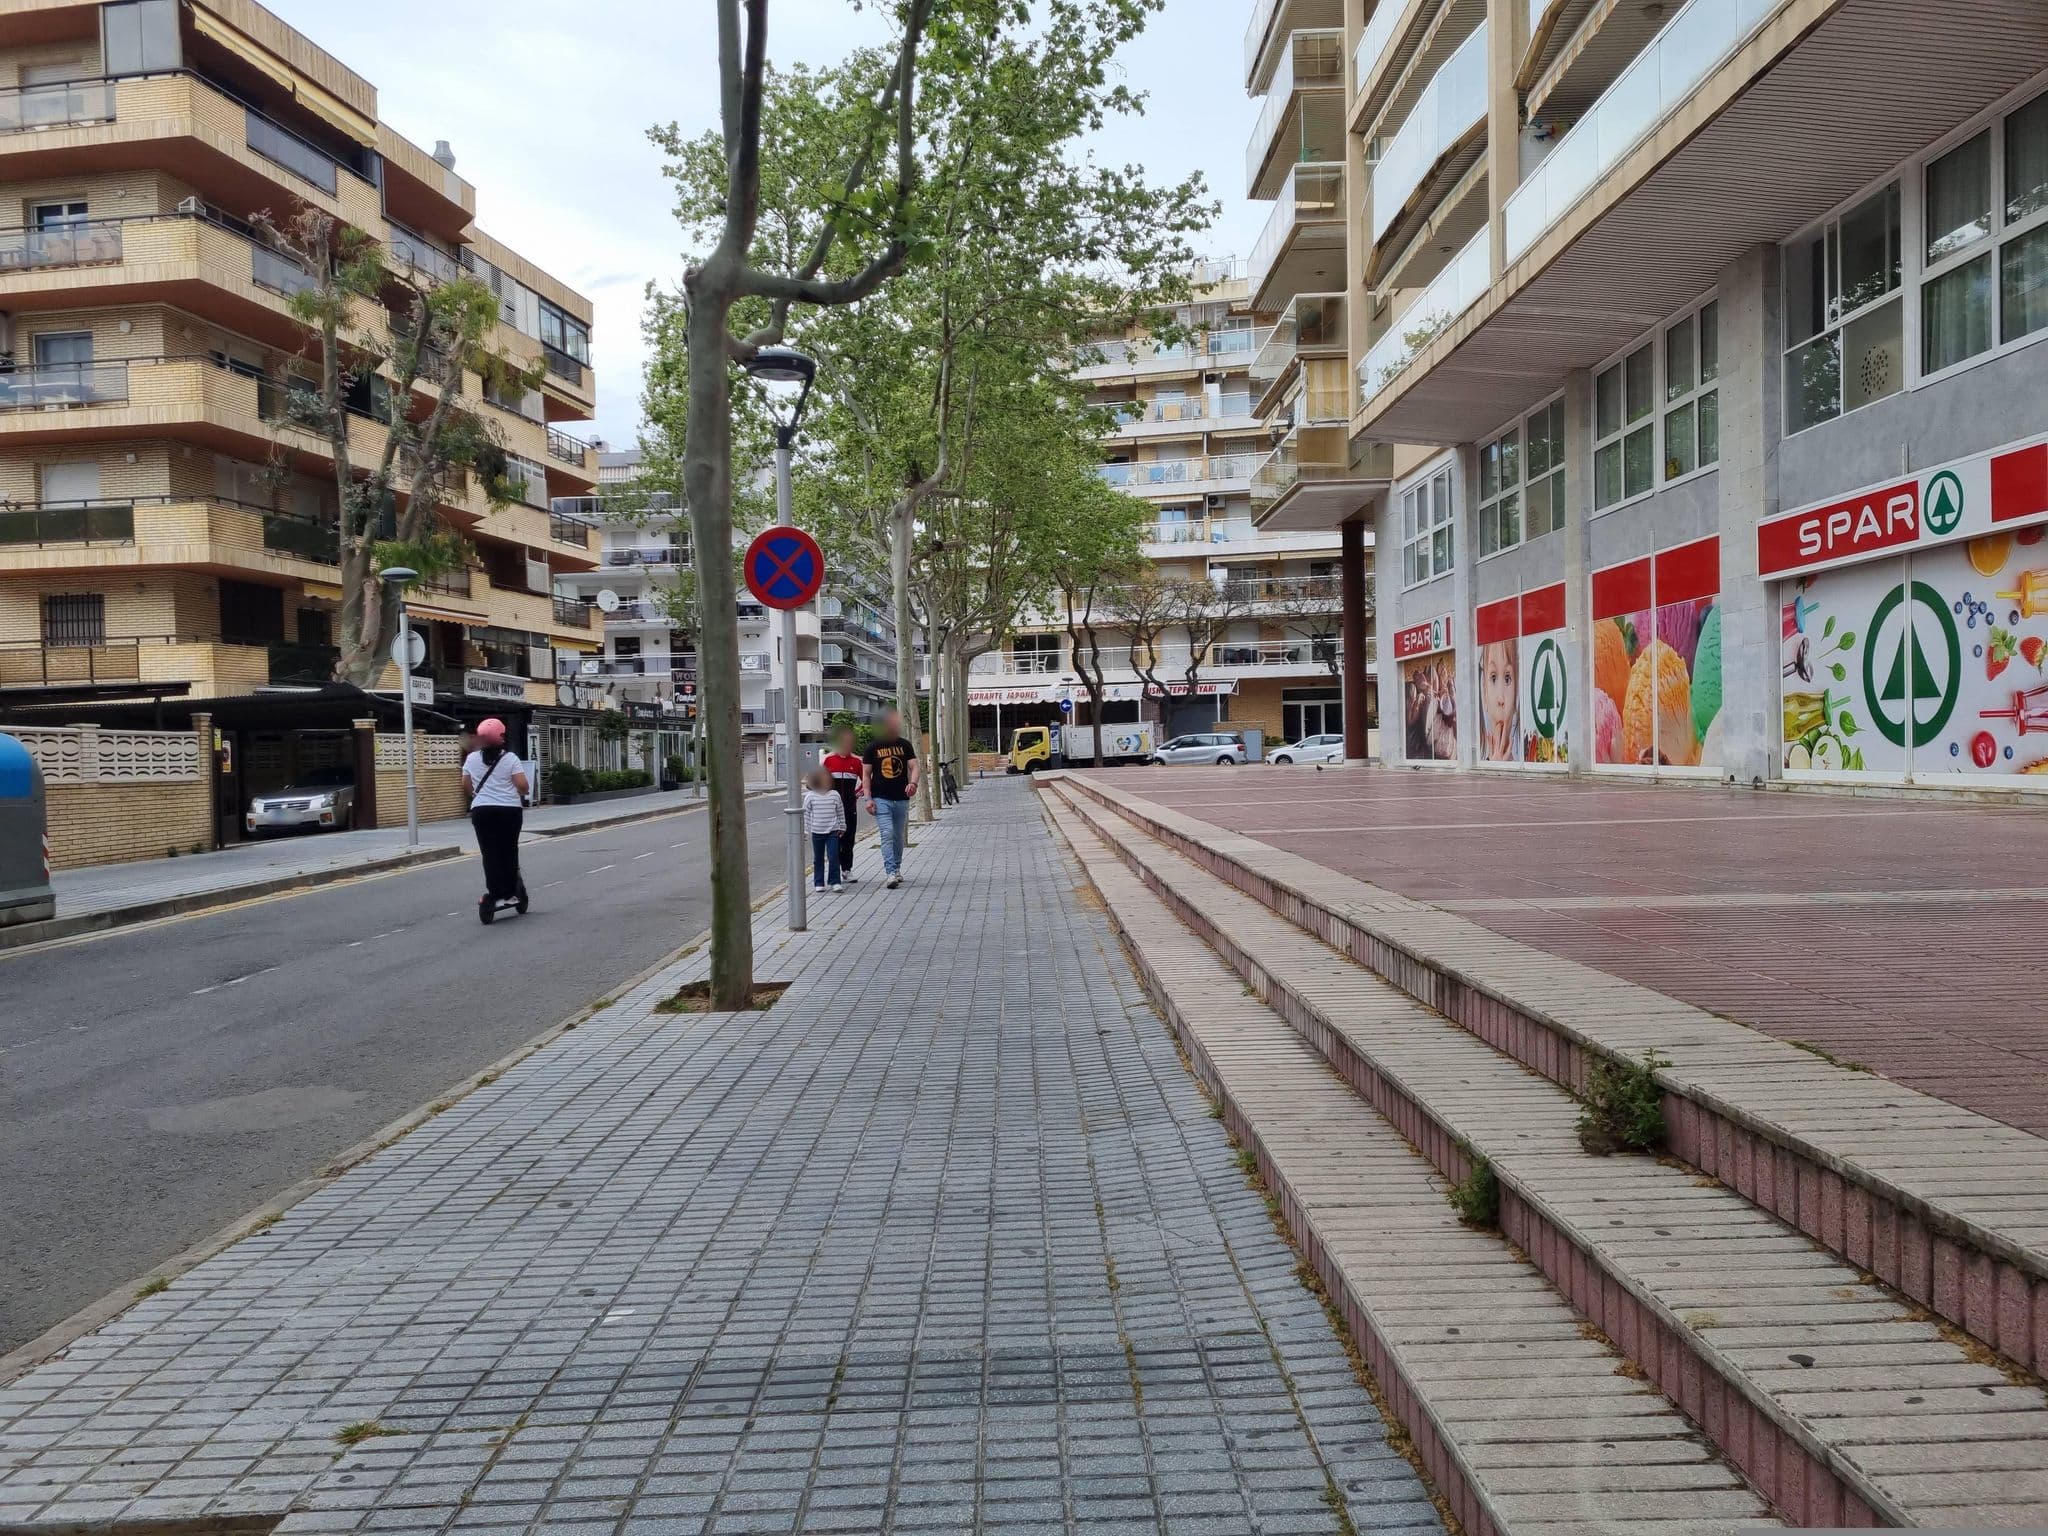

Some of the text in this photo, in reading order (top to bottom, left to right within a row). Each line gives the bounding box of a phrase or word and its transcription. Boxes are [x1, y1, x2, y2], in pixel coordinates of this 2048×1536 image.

[1799, 493, 1915, 557] SPAR
[1403, 628, 1431, 652] SPAR
[501, 682, 521, 697] TATTOO
[1006, 691, 1039, 700] JAPONES
[1168, 684, 1217, 694] TEPPYAKI
[877, 746, 905, 758] NIRVANA
